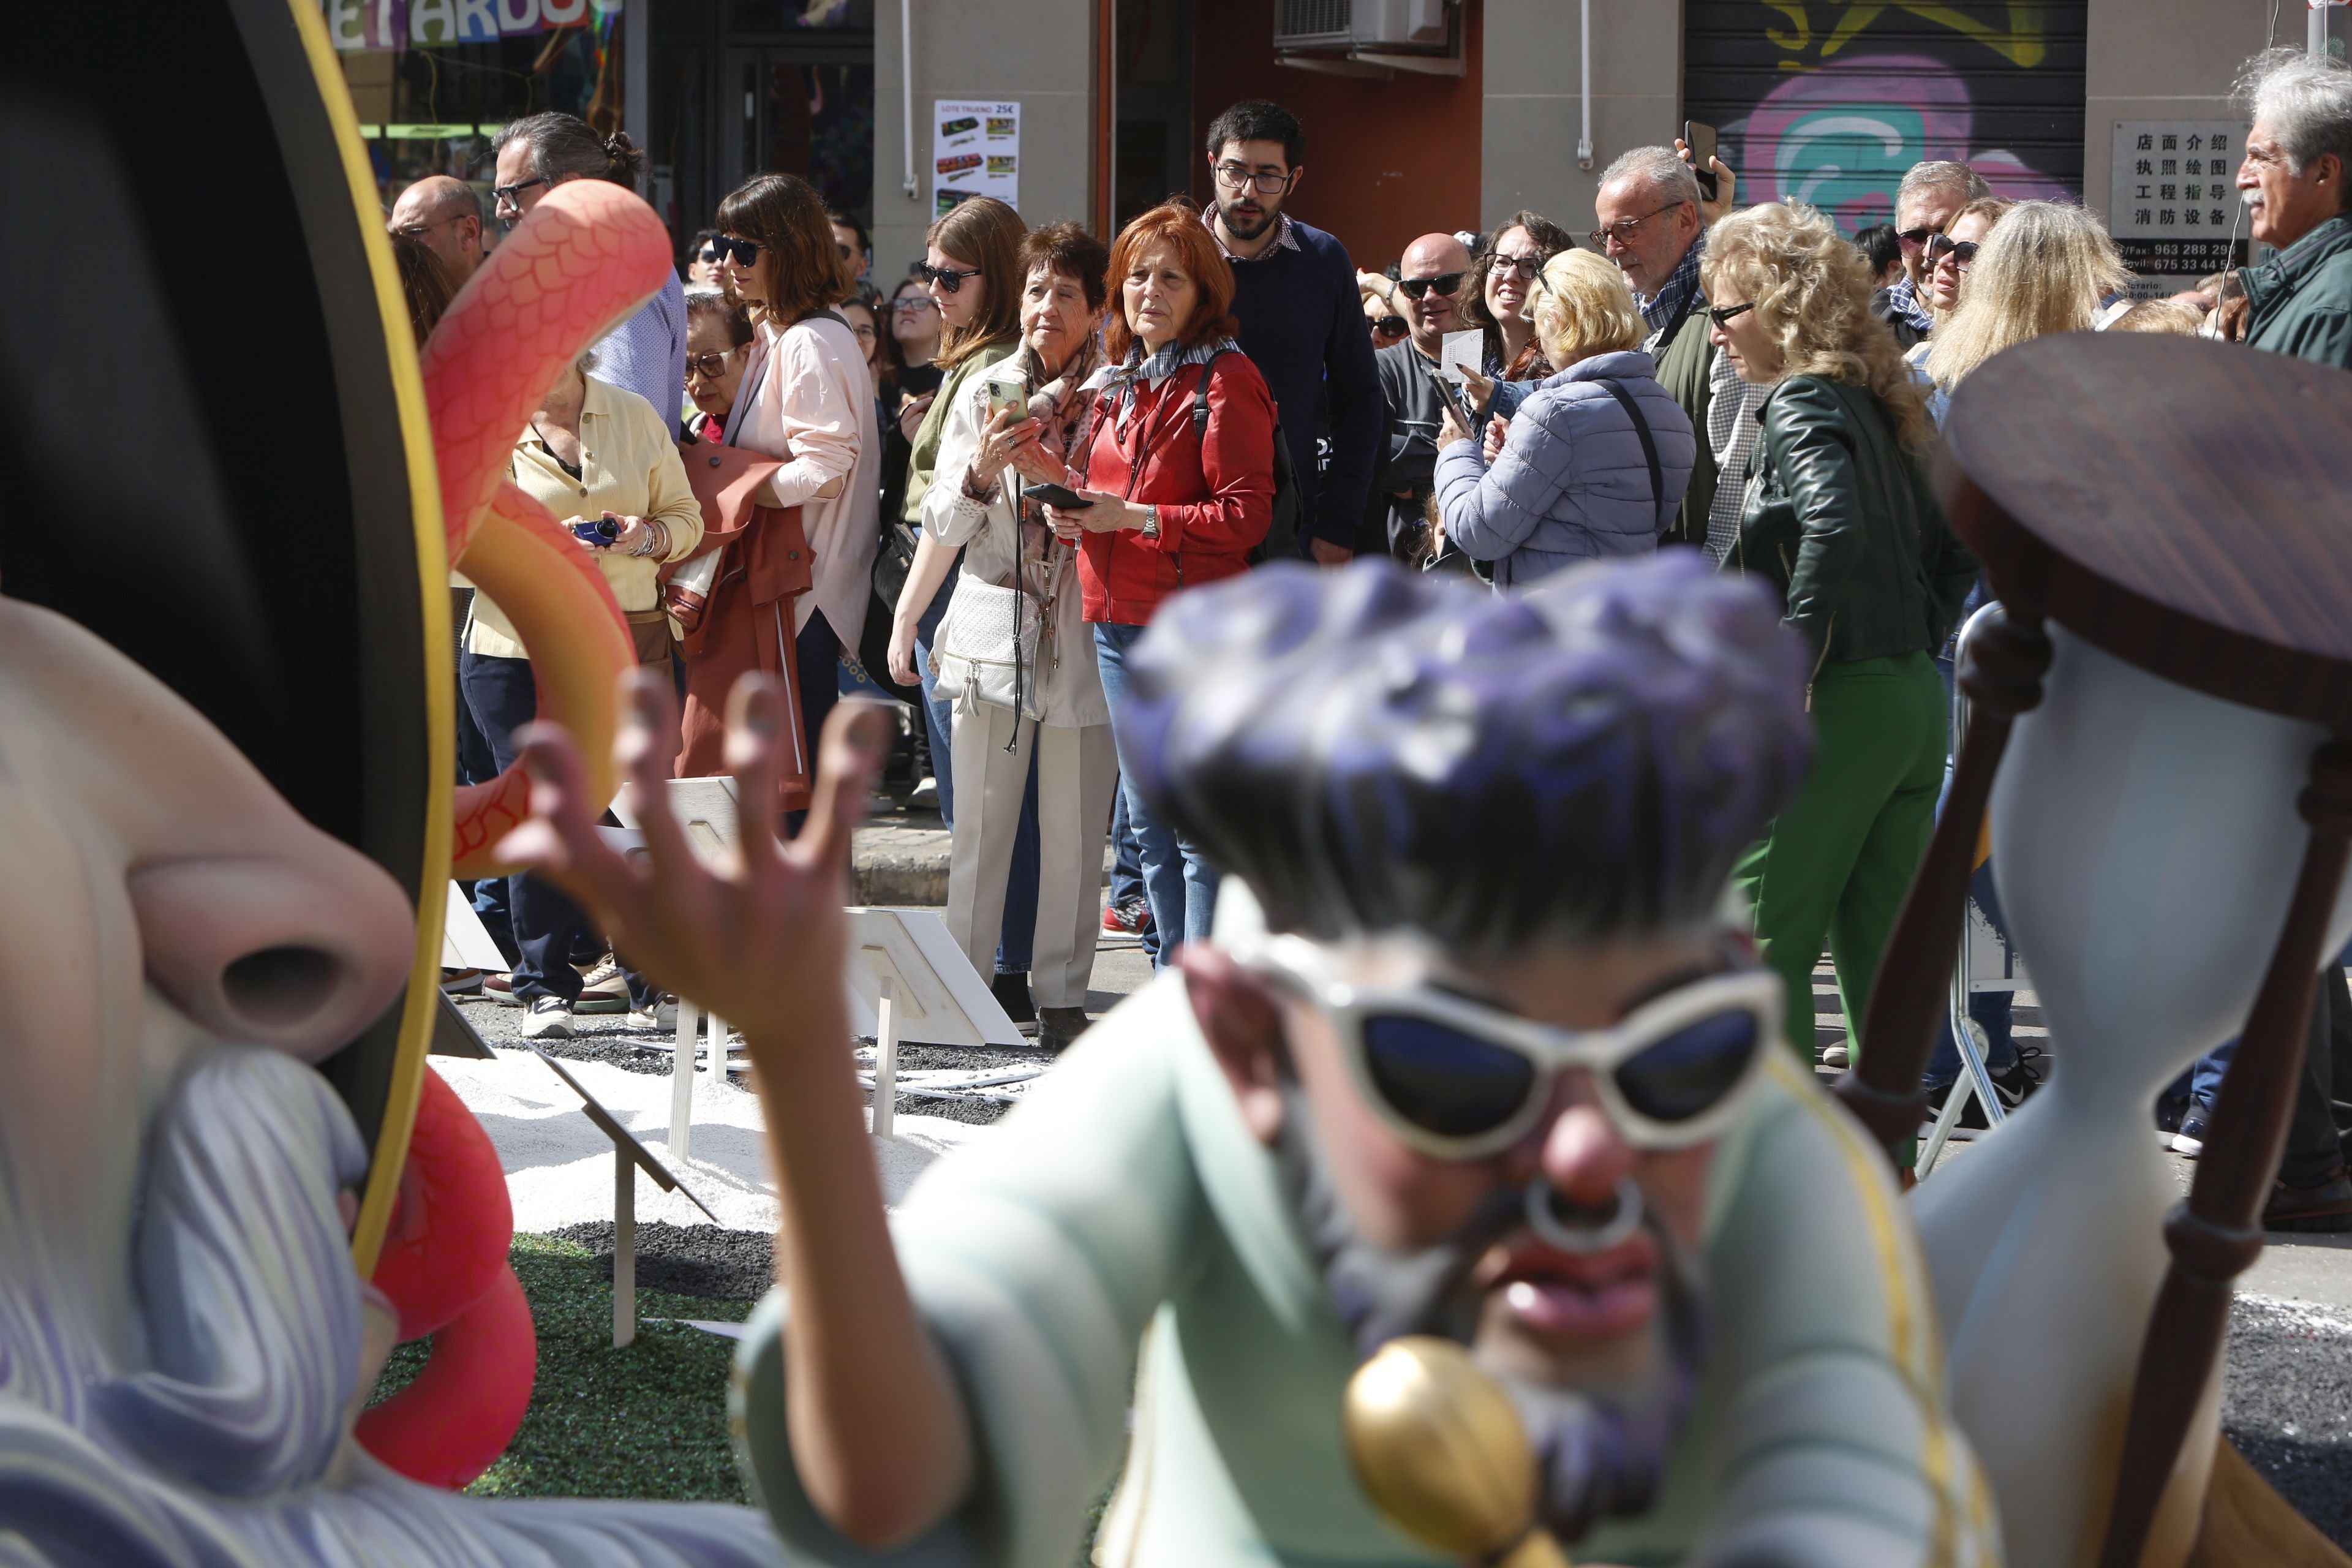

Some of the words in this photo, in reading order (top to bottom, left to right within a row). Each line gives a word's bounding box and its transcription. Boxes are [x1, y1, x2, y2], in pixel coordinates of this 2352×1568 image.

[996, 105, 1014, 113] 25€
[2136, 134, 2227, 151] 店面介绍
[2136, 159, 2226, 176] 执照绘图
[2135, 184, 2226, 200] 工程指导
[2135, 208, 2225, 225] 消防设备
[2154, 244, 2179, 255] 963
[2183, 244, 2207, 255] 288
[2154, 259, 2178, 270] 675
[2181, 259, 2197, 270] 33
[2201, 259, 2217, 270] 44
